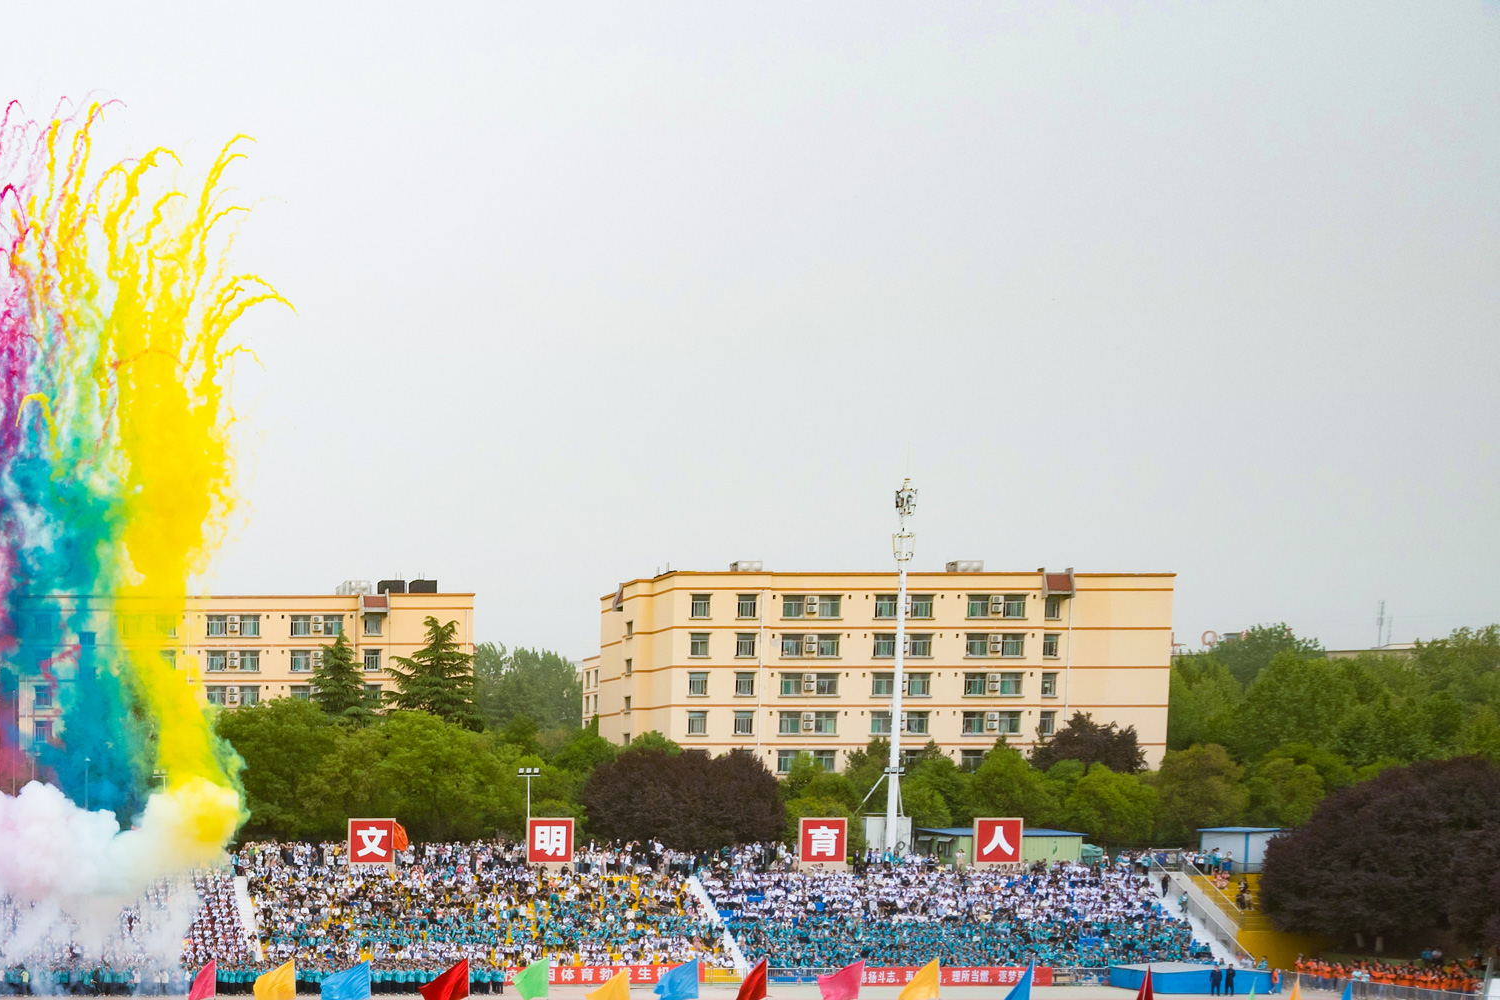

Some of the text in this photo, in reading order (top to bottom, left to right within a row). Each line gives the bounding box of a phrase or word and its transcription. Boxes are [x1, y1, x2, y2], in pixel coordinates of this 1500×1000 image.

[356, 826, 388, 857] 文
[534, 826, 567, 857] 明
[808, 826, 840, 857] 育
[982, 826, 1015, 857] 人
